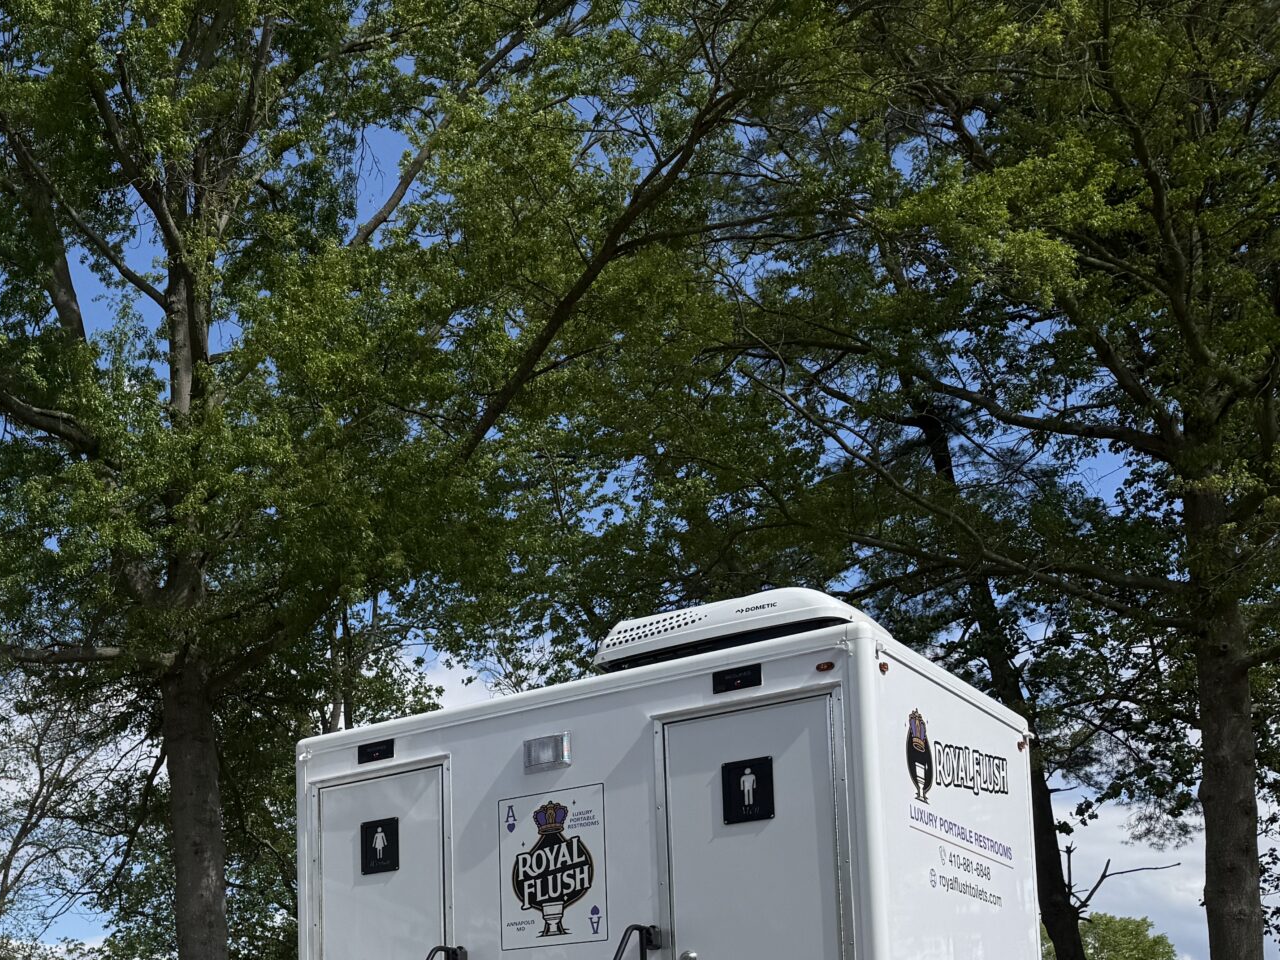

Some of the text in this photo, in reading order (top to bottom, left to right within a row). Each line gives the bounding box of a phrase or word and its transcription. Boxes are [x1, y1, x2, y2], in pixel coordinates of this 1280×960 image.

[745, 602, 777, 613] DOMETIC
[504, 804, 518, 823] A
[569, 815, 596, 824] PORTABLE
[572, 809, 593, 817] LUXURY
[567, 821, 600, 830] RESTROOMS
[909, 804, 1013, 861] LUXURY PORTABLE RESTROOMS
[517, 837, 586, 881] ROYAL
[521, 865, 590, 909] FLUSH
[939, 875, 1003, 907] royalflushtoilets.com
